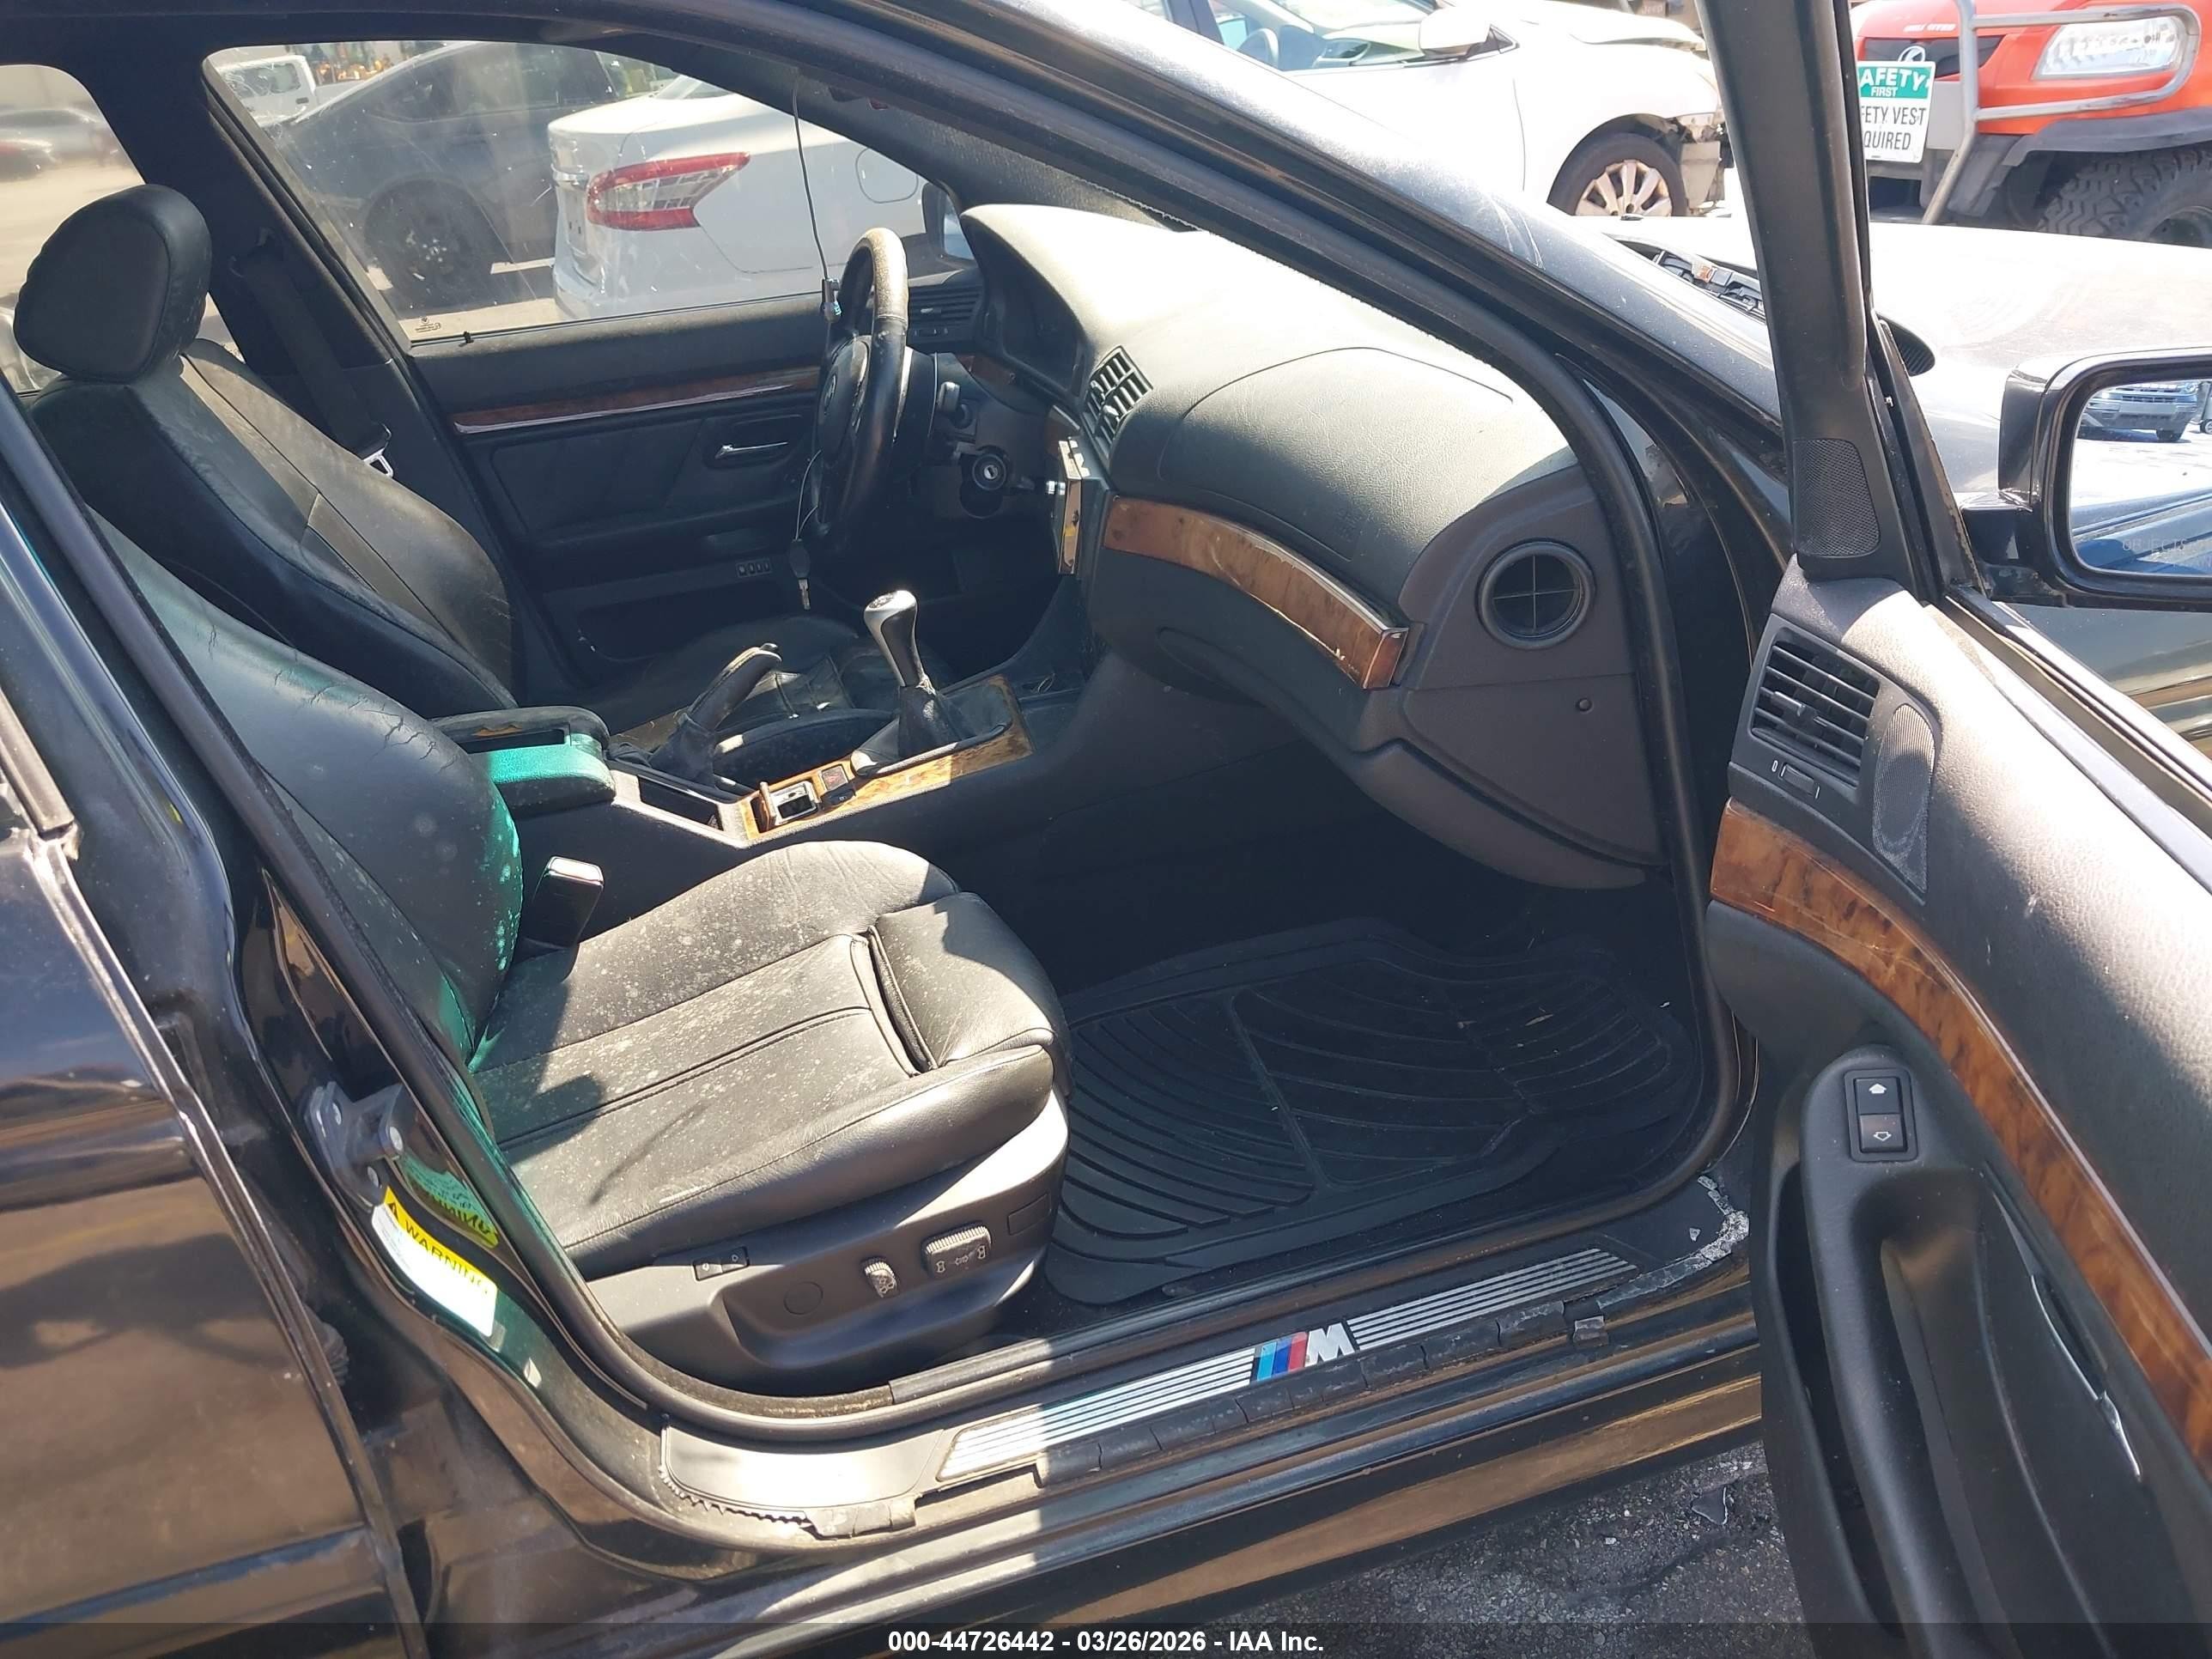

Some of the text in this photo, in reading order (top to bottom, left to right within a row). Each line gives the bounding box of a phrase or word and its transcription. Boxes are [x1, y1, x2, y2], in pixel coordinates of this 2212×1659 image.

[1860, 67, 1926, 91] AFETY
[1871, 87, 1899, 97] FIRST
[1862, 106, 1926, 125] ETY VEST
[1863, 130, 1911, 150] QUIRED
